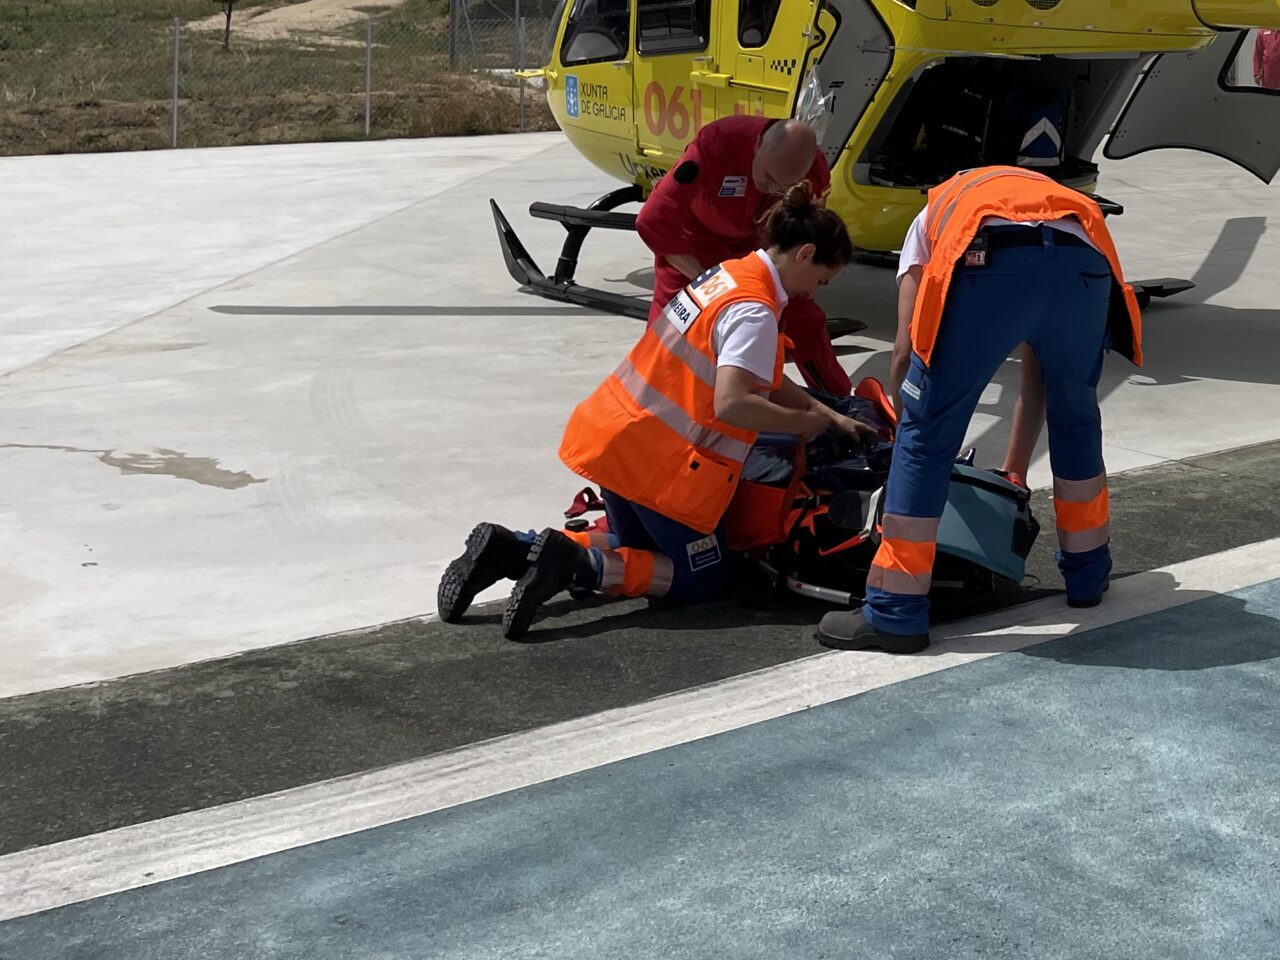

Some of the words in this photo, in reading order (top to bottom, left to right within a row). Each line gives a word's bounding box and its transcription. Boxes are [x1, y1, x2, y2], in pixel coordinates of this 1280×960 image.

[581, 82, 608, 100] XUNTA
[581, 100, 591, 114] DE
[592, 103, 626, 122] GALICIA
[644, 80, 702, 140] 061
[619, 152, 668, 180] Urxen
[692, 536, 714, 552] 061
